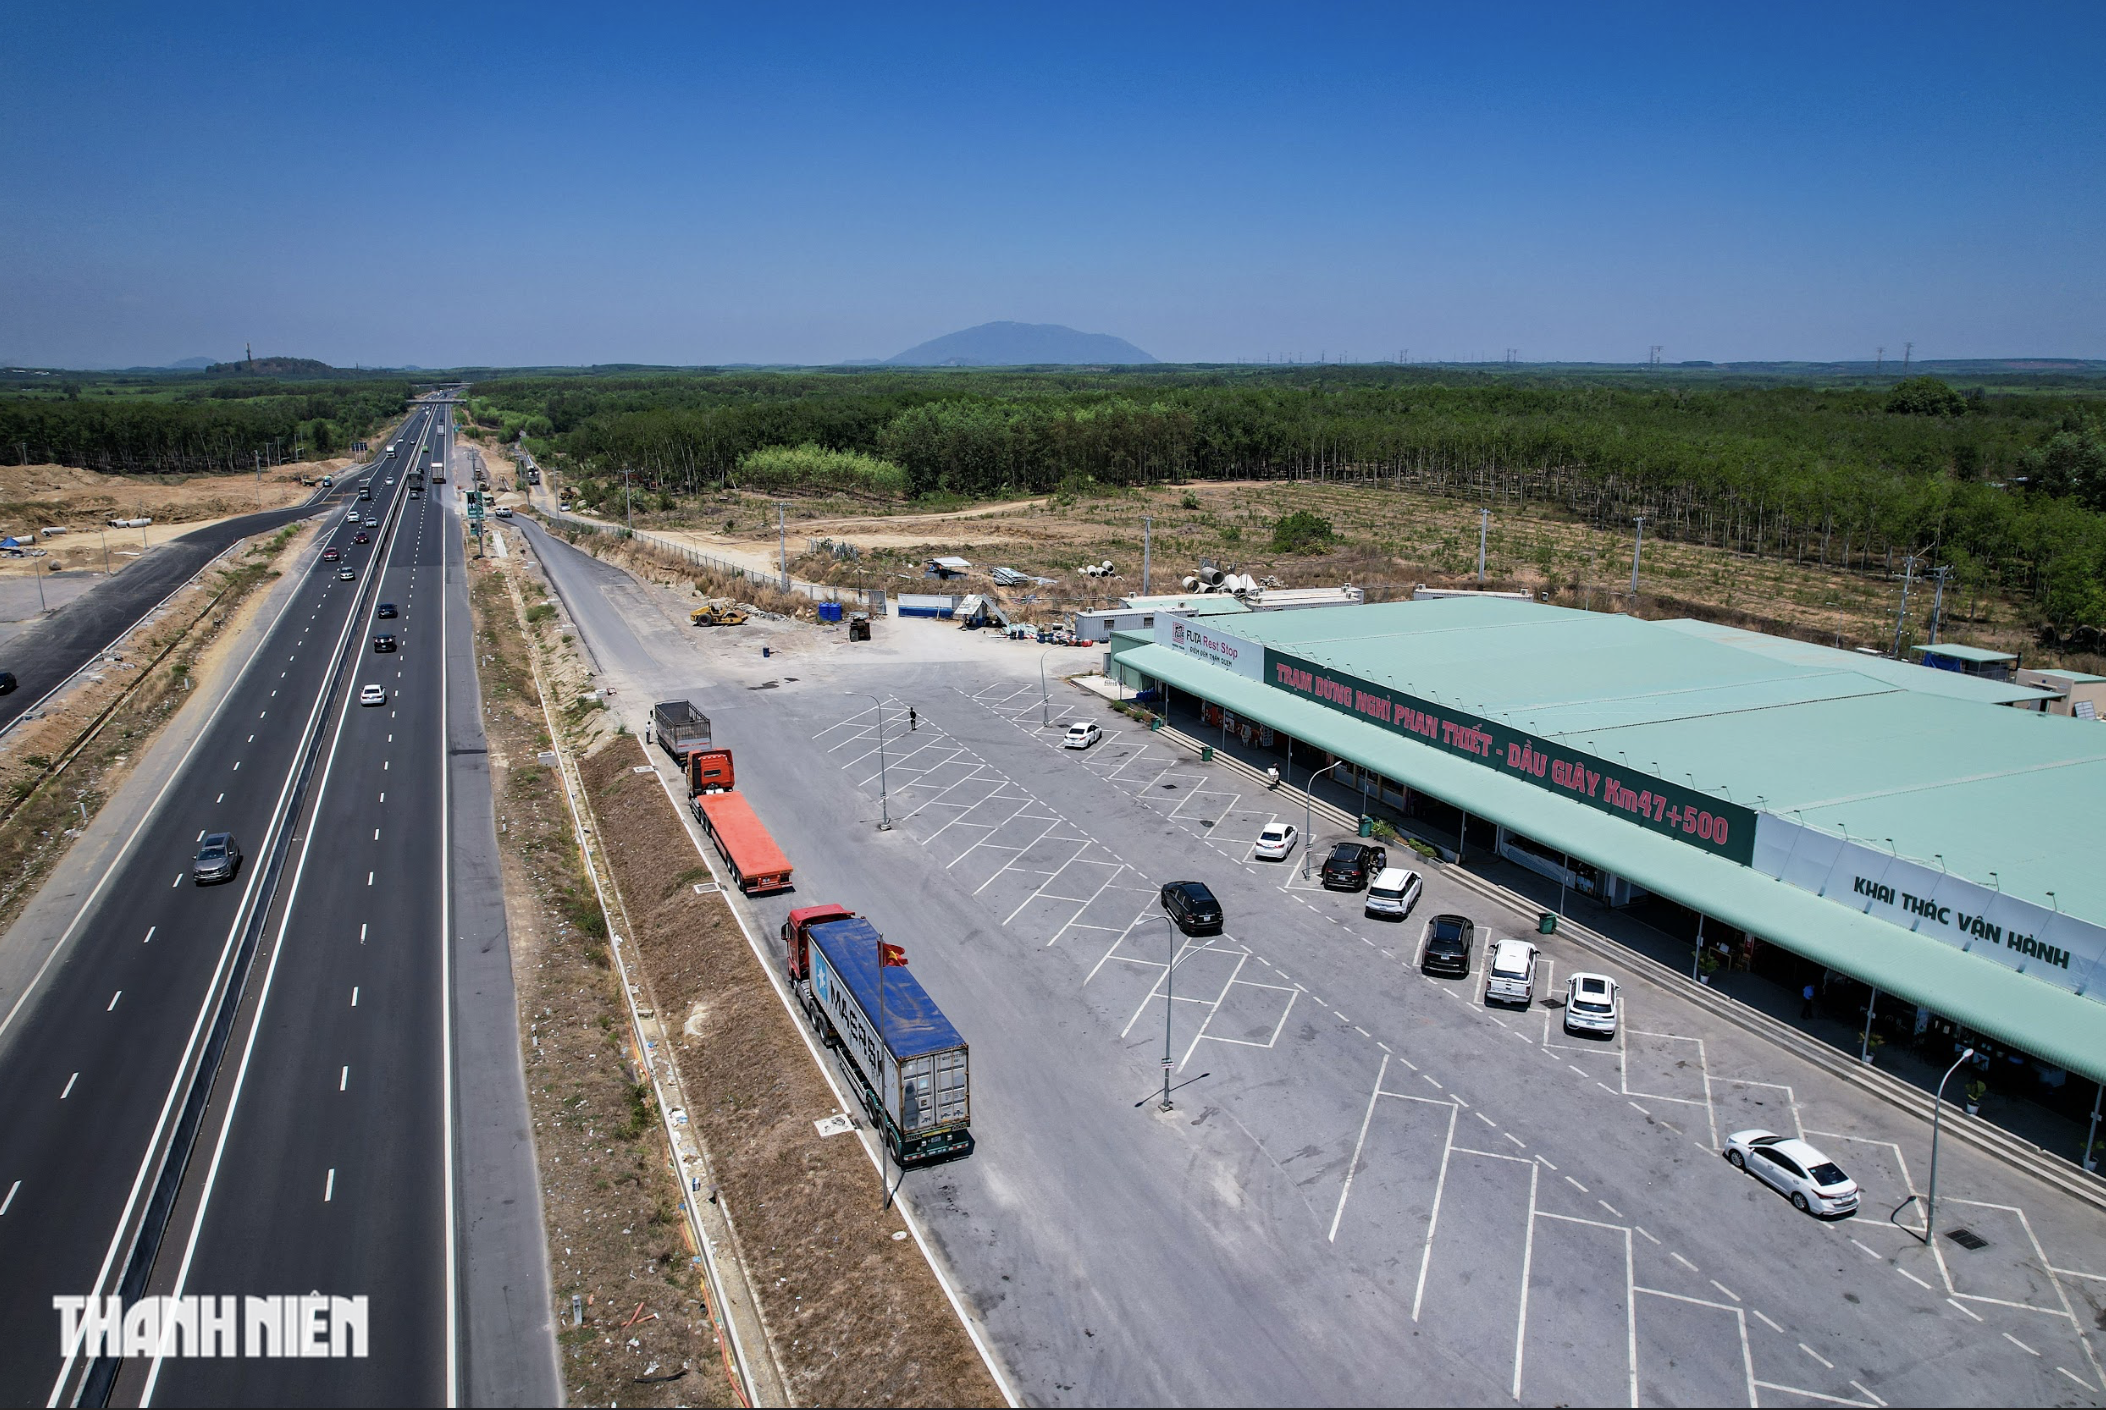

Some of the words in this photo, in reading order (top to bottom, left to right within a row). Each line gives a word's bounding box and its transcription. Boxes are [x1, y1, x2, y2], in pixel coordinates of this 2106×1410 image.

[1186, 630, 1201, 645] FUTA
[1203, 635, 1219, 652] Rest
[1221, 642, 1238, 660] Stop
[1276, 662, 1313, 693] TRẠM
[1315, 675, 1353, 708] DỪNG
[1355, 694, 1392, 722] NGHỈ
[1393, 703, 1439, 740] PHAN
[1441, 723, 1493, 757] THIẾT
[1507, 739, 1548, 778] DẦU
[1551, 759, 1600, 797] GIÂY
[1604, 777, 1728, 845] Km47+500
[1853, 875, 1896, 906] KHAI
[1901, 892, 1951, 926] THÁC
[1957, 911, 2002, 945] VẬN
[2006, 930, 2070, 970] HÀNH
